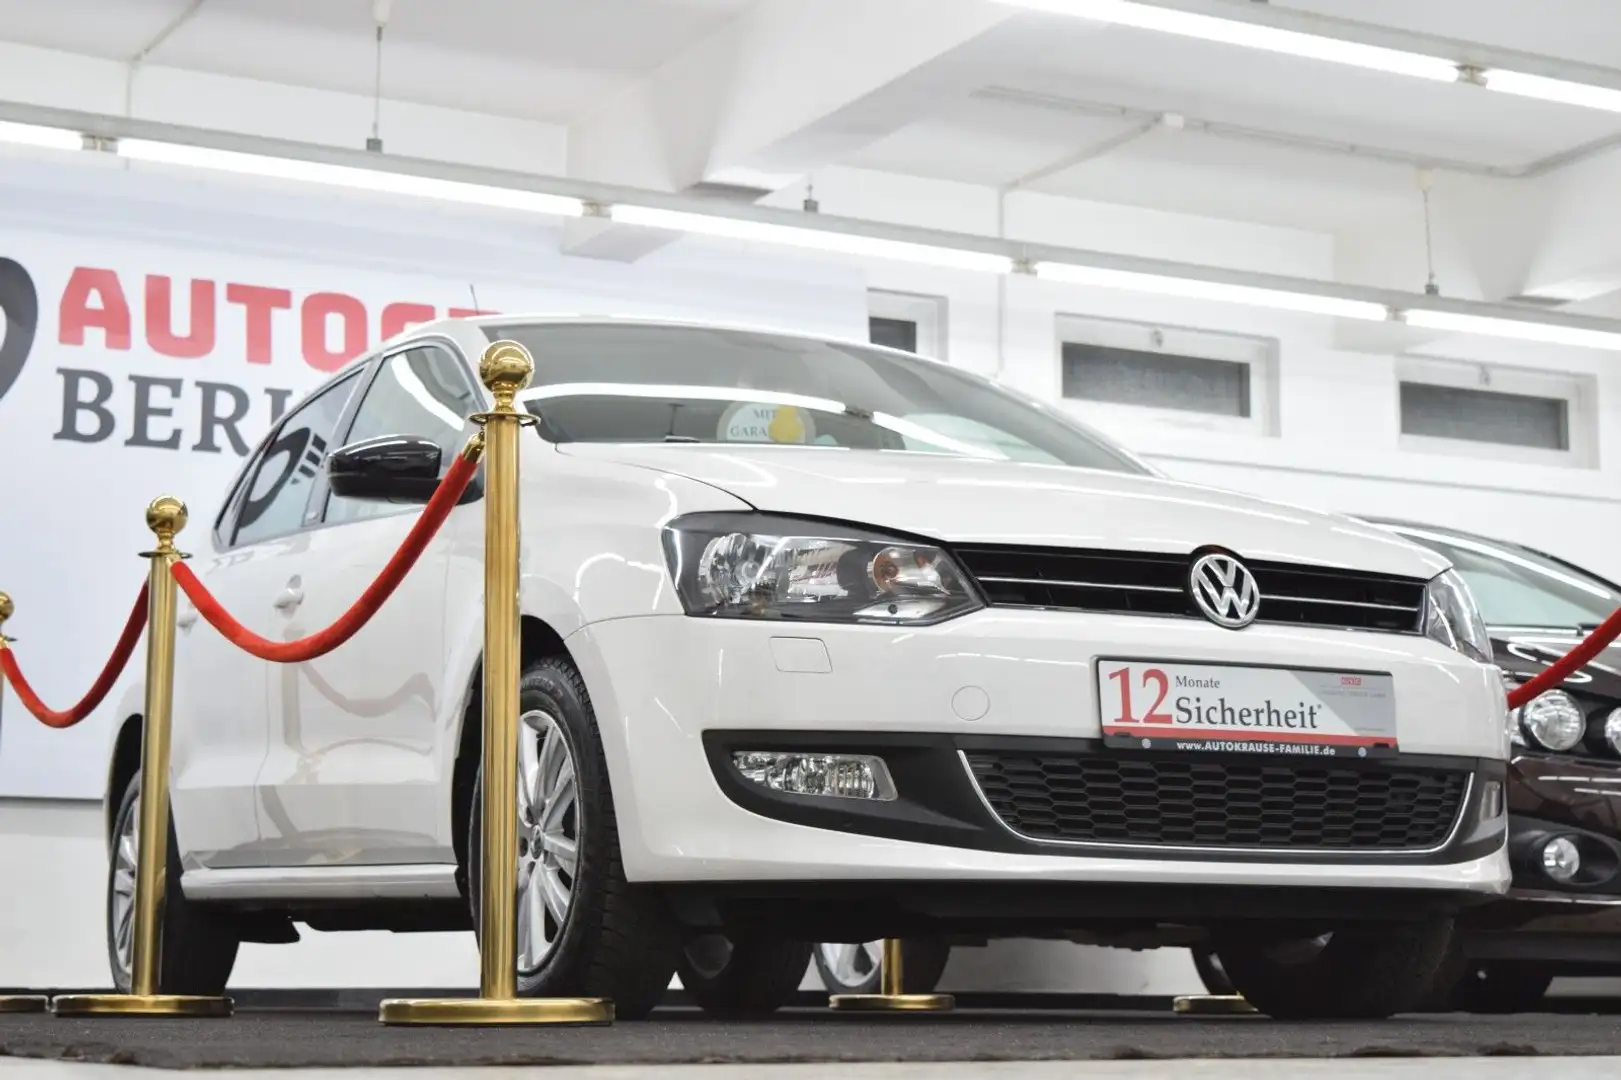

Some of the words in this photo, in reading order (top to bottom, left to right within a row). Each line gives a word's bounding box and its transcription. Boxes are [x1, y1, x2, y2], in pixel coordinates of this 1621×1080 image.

[58, 266, 504, 373] AUTO
[730, 424, 768, 437] GARA
[1193, 556, 1258, 625] VW
[1108, 667, 1173, 724] 12
[1175, 675, 1221, 689] Monate
[1176, 740, 1336, 756] www.AUTOKRAUSE-FAMILIE.de
